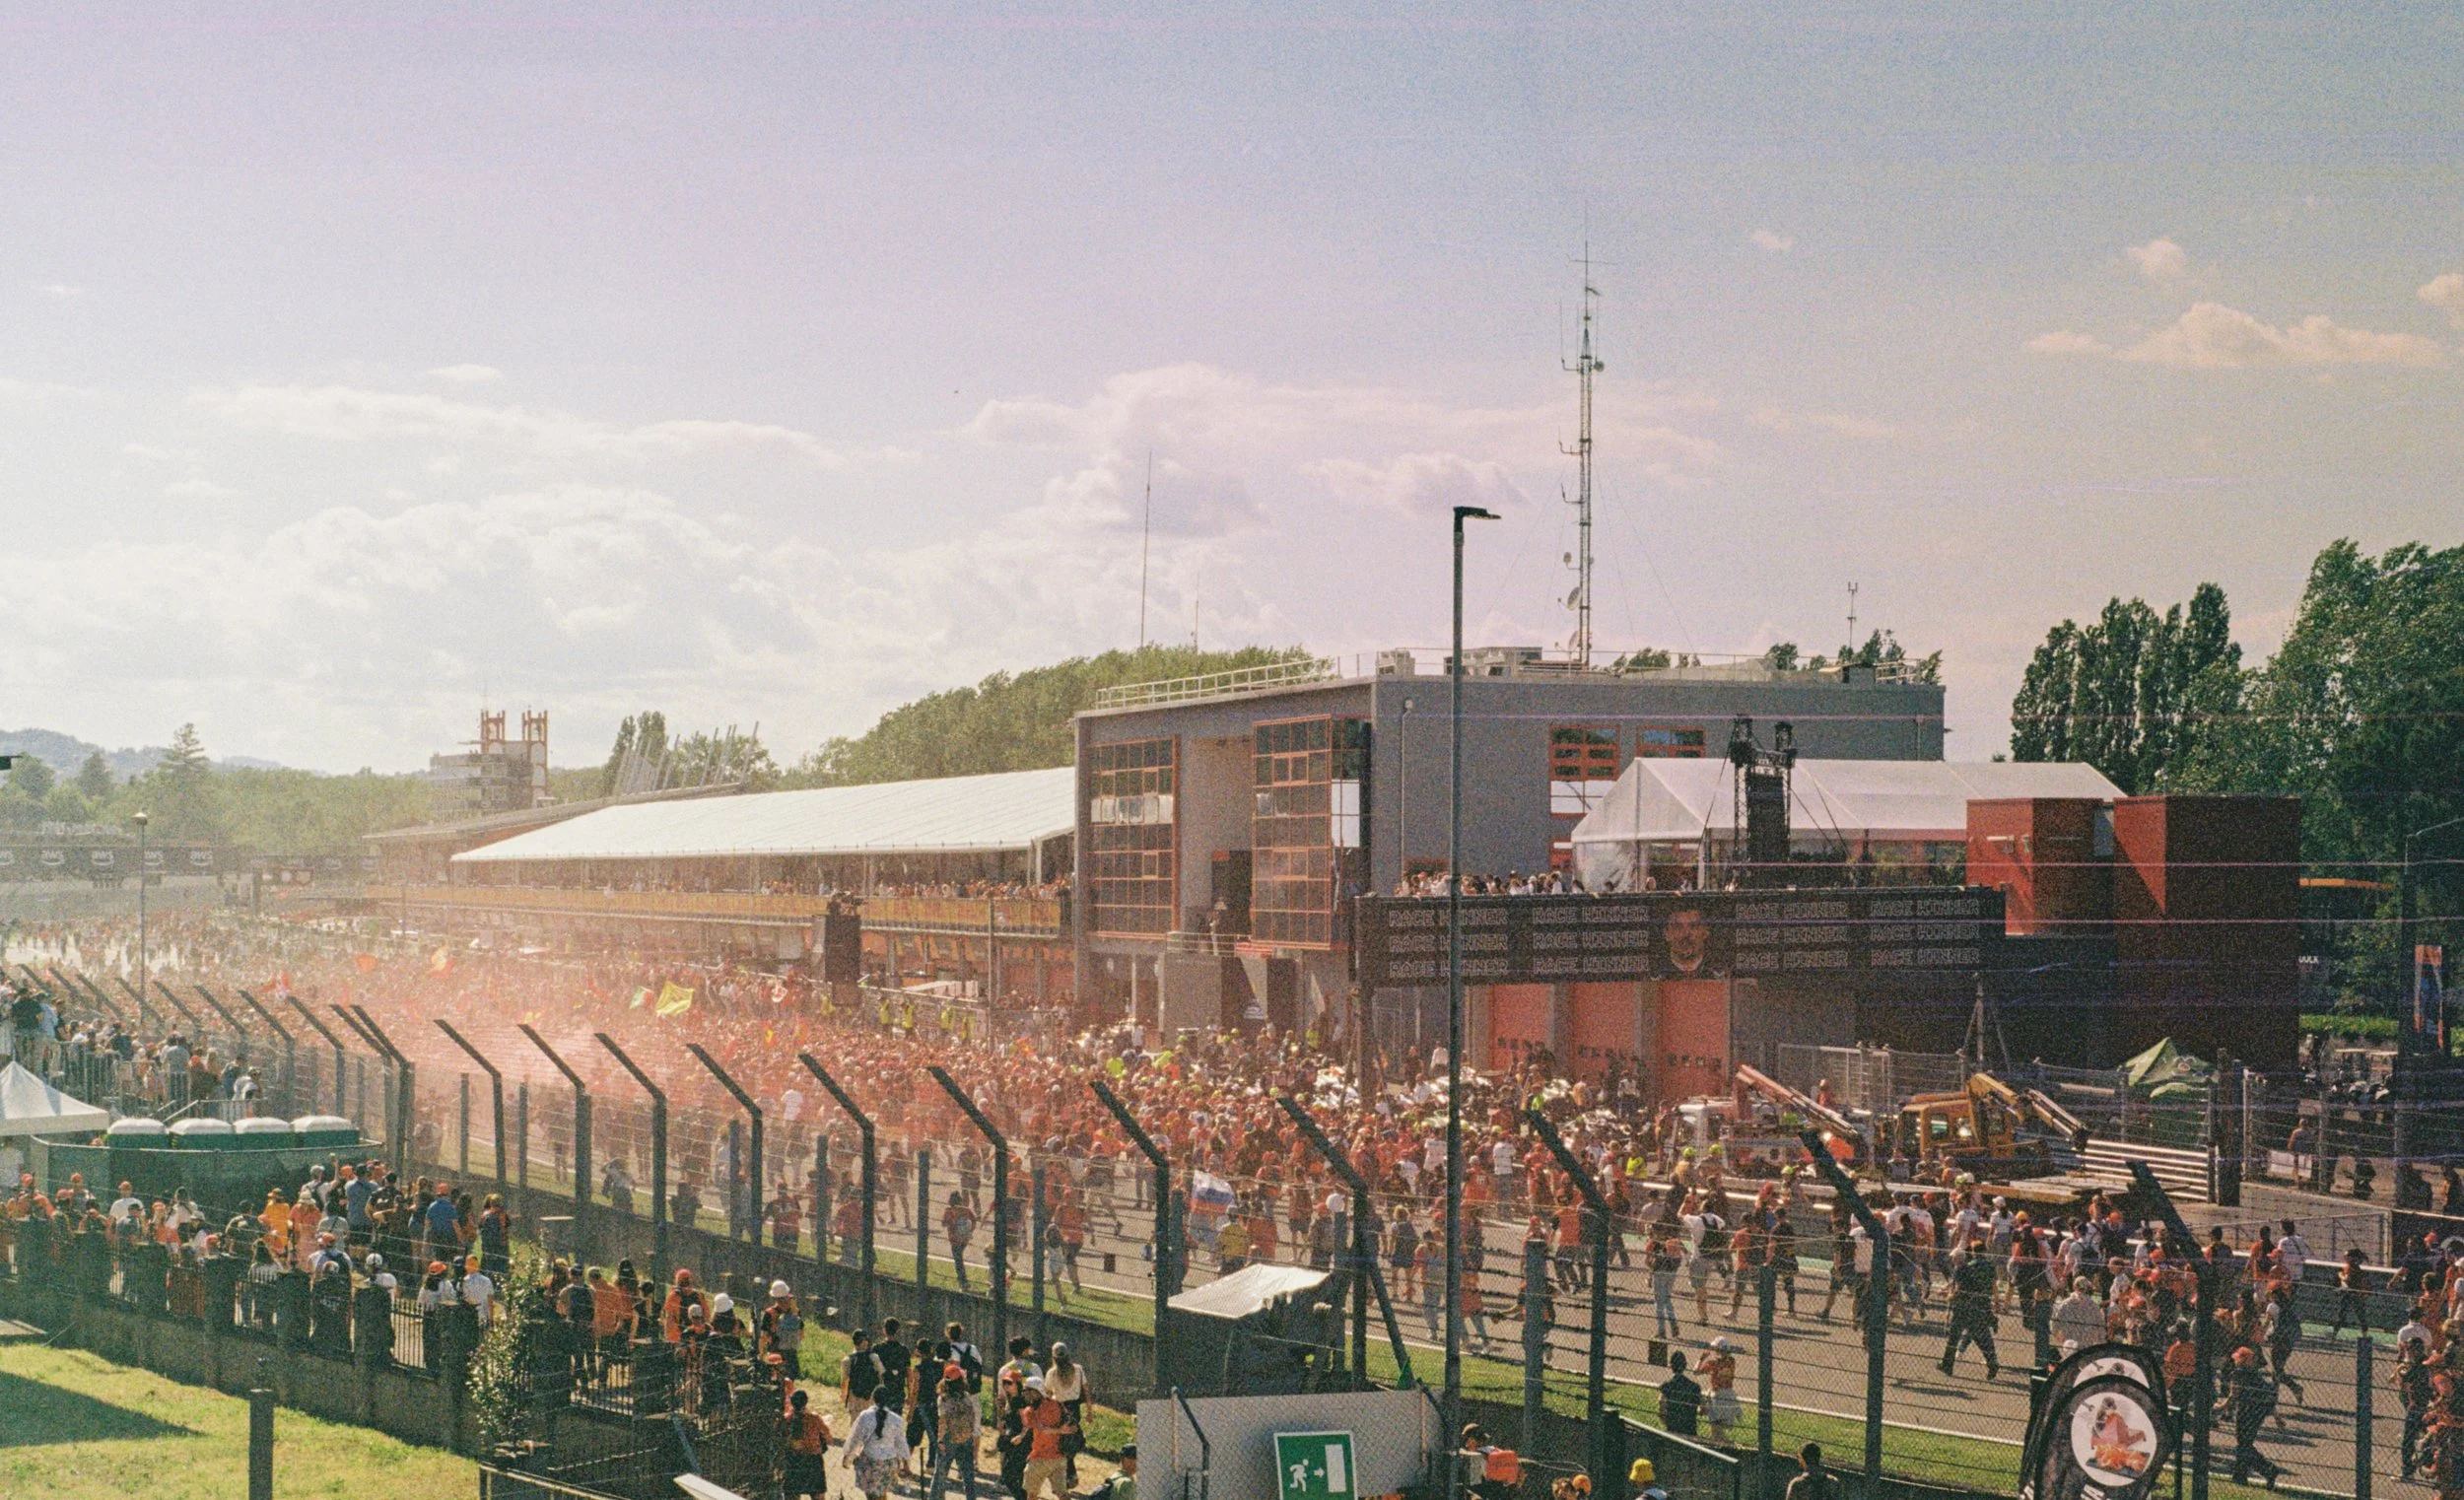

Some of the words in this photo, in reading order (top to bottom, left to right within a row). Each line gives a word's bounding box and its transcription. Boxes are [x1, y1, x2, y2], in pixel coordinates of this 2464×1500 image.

[1533, 908, 1577, 924] RACE
[1582, 906, 1649, 922] WINNER
[1736, 903, 1779, 920] RACE
[1783, 901, 1848, 918] WINNER
[1871, 900, 1912, 917] RACE
[1916, 898, 1979, 916] WINNER
[1390, 911, 1434, 926] RACE
[1439, 908, 1508, 925] WNNER
[1533, 932, 1577, 949] RACE
[1582, 930, 1649, 947] WINNER
[1736, 928, 1779, 944] RACE
[1783, 926, 1848, 942] WINNER
[1871, 925, 1912, 941] RACE
[1916, 923, 1979, 939] WINNER
[1390, 935, 1436, 952] RACE
[1439, 933, 1508, 951] WNNER
[1533, 957, 1577, 975] RACE
[1582, 956, 1649, 973] WINNER
[1736, 953, 1779, 969] RACE
[1783, 951, 1848, 967] WINNER
[1871, 950, 1912, 966] RACE
[1916, 948, 1979, 965] WINNER
[1390, 961, 1436, 978] RACE
[1439, 959, 1508, 977] WNNER
